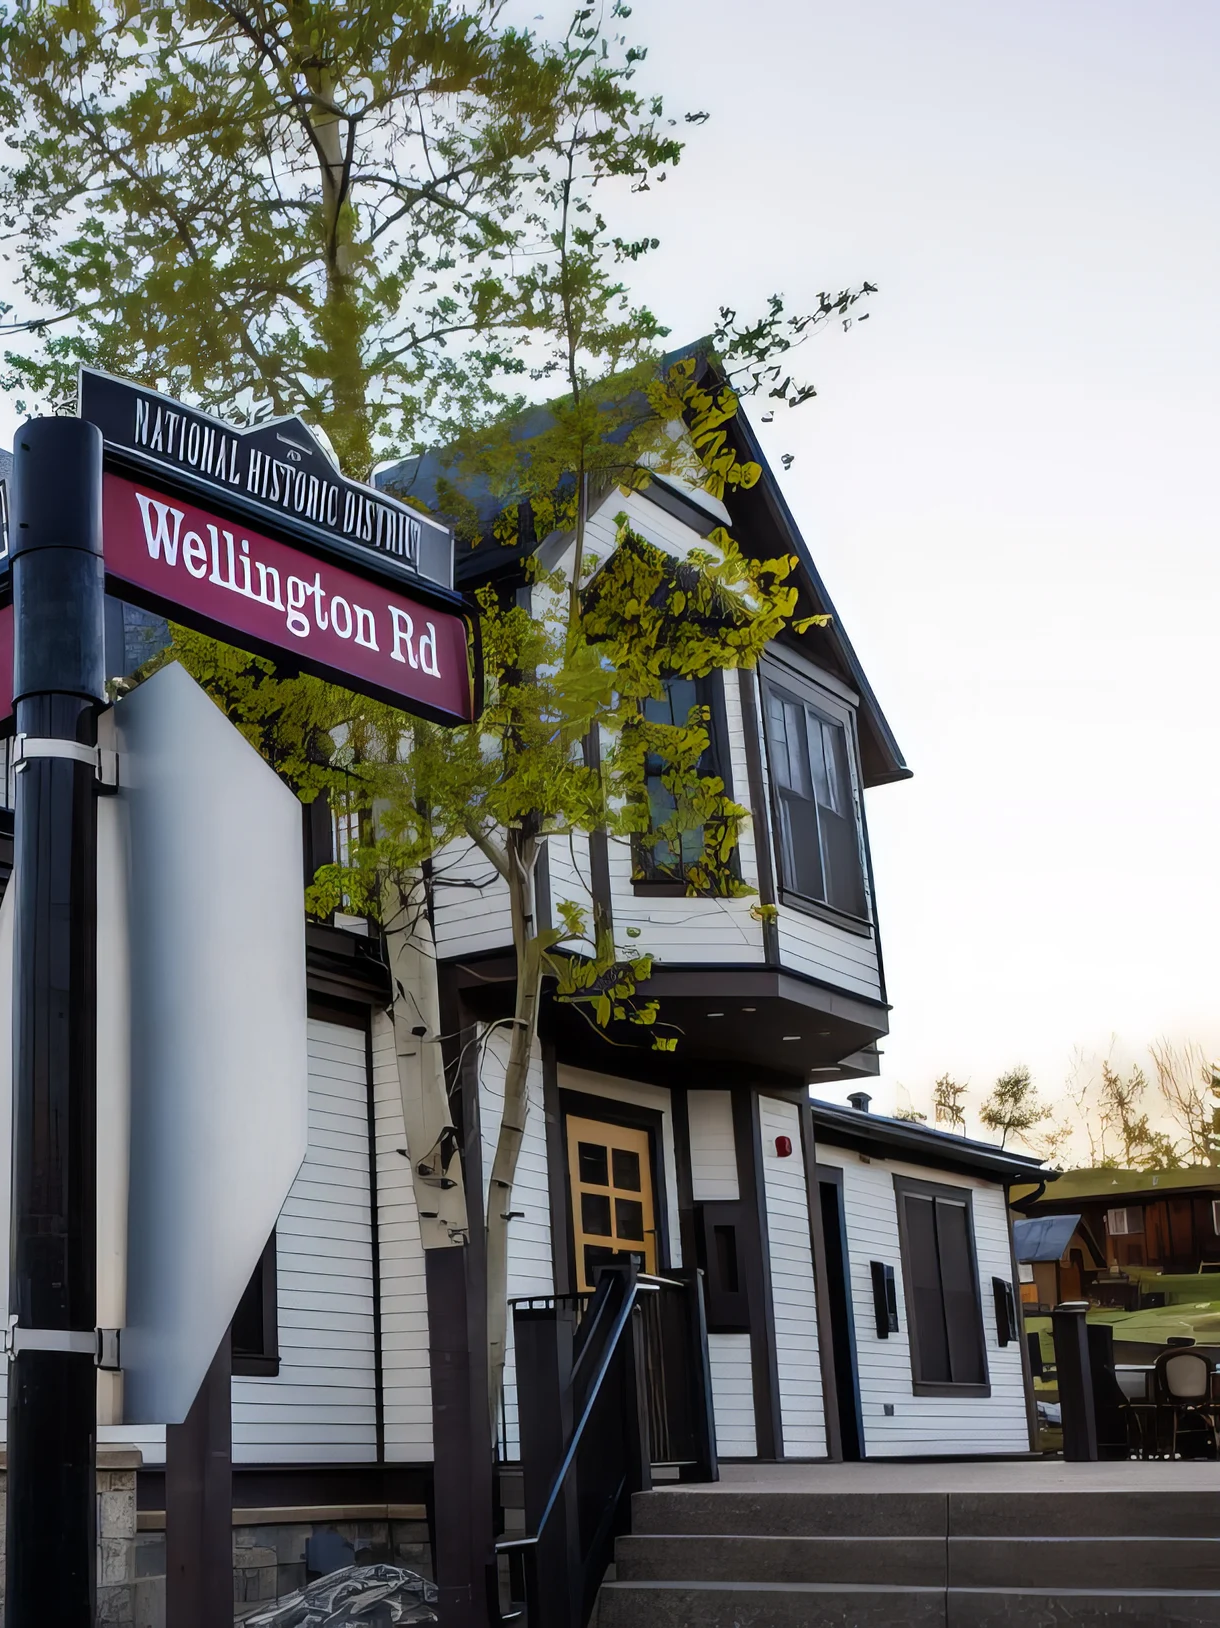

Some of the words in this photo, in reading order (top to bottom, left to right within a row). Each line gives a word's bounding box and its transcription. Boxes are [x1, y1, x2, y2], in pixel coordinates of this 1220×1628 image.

[135, 397, 241, 485] NATIONAL
[247, 448, 339, 527] HISTORIC
[343, 490, 421, 566] DISTRICT
[135, 492, 380, 653] Wellington
[387, 604, 442, 679] Rd
